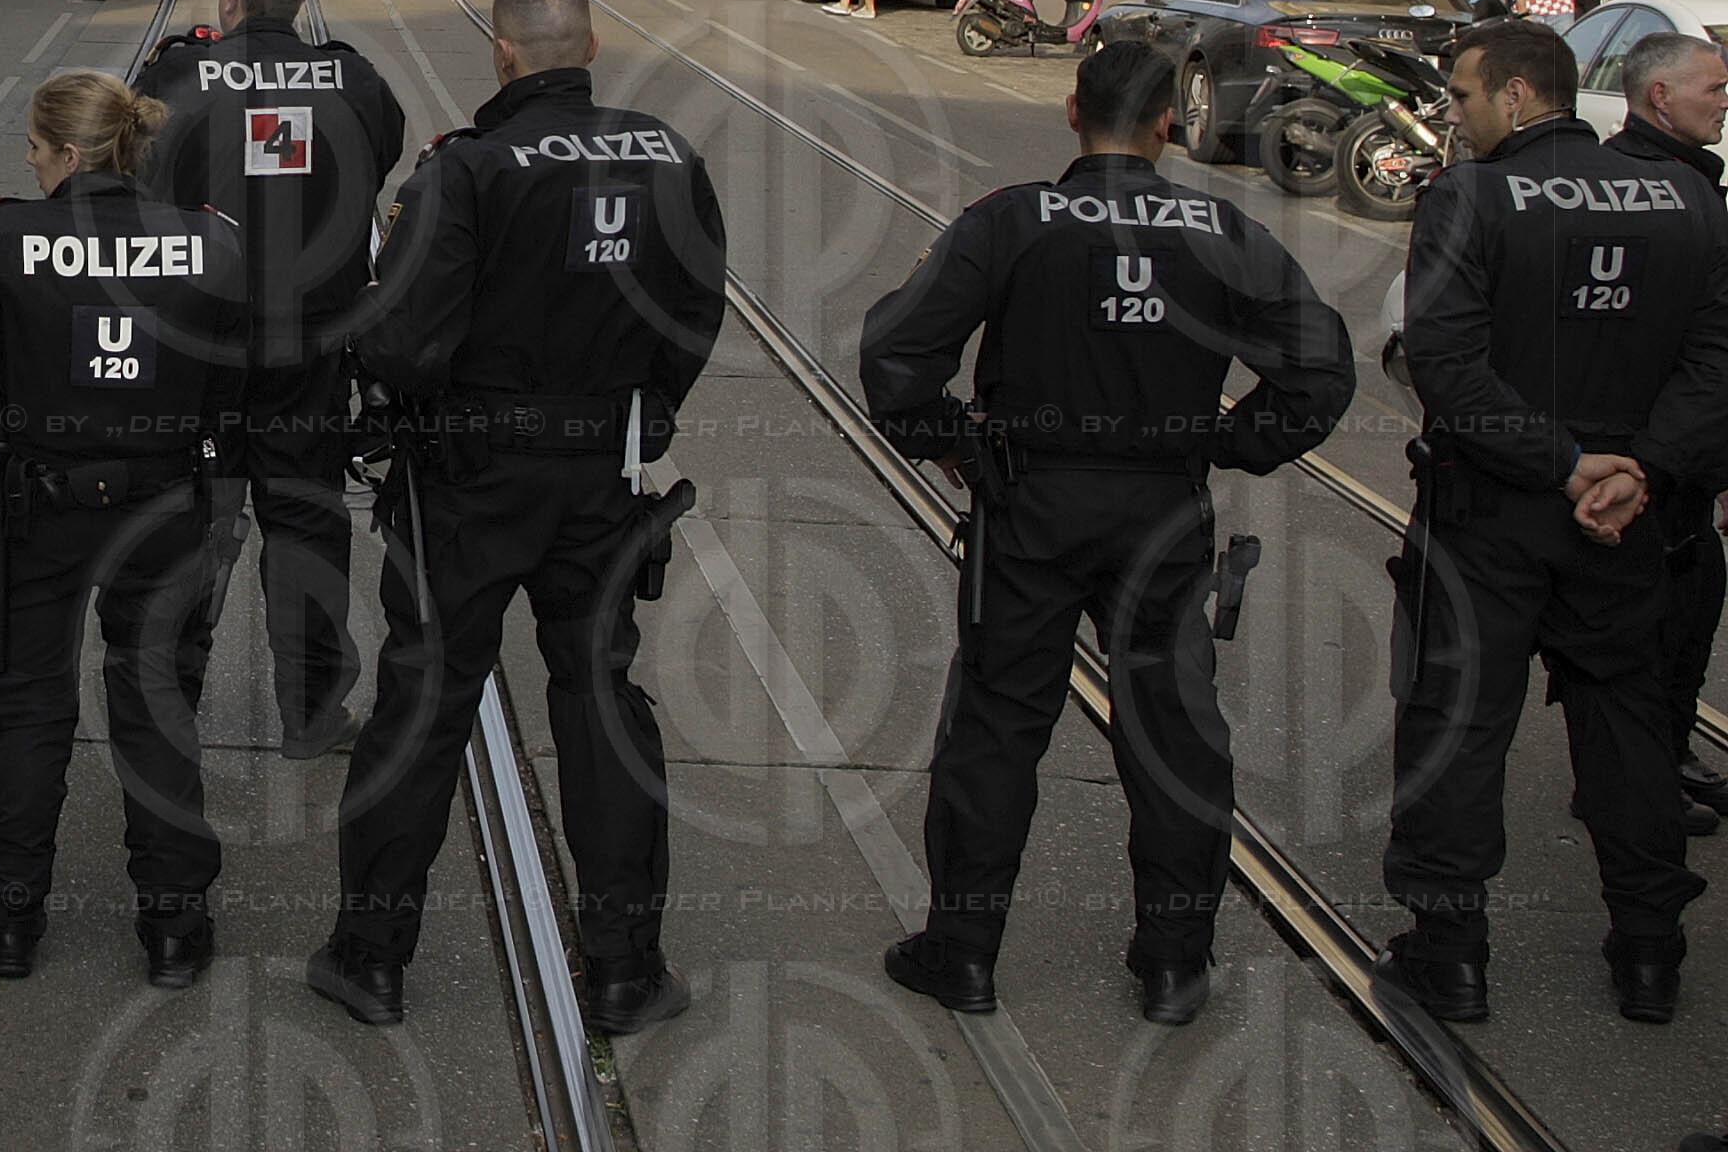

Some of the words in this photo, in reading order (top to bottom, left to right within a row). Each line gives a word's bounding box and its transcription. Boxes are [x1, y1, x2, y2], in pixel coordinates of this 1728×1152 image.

[198, 59, 344, 92] POLIZEI
[263, 119, 298, 166] 4
[510, 129, 683, 167] POLIZEI
[1505, 174, 1687, 212] POLIZEI
[593, 196, 627, 234] U
[1039, 189, 1224, 236] POLIZEI
[22, 234, 205, 279] POLIZEI
[584, 238, 631, 263] 120
[1590, 246, 1625, 282] U
[1115, 255, 1154, 293] U
[1100, 296, 1166, 324] 120
[1571, 284, 1631, 311] 120
[97, 315, 133, 353] U
[88, 355, 140, 380] 120
